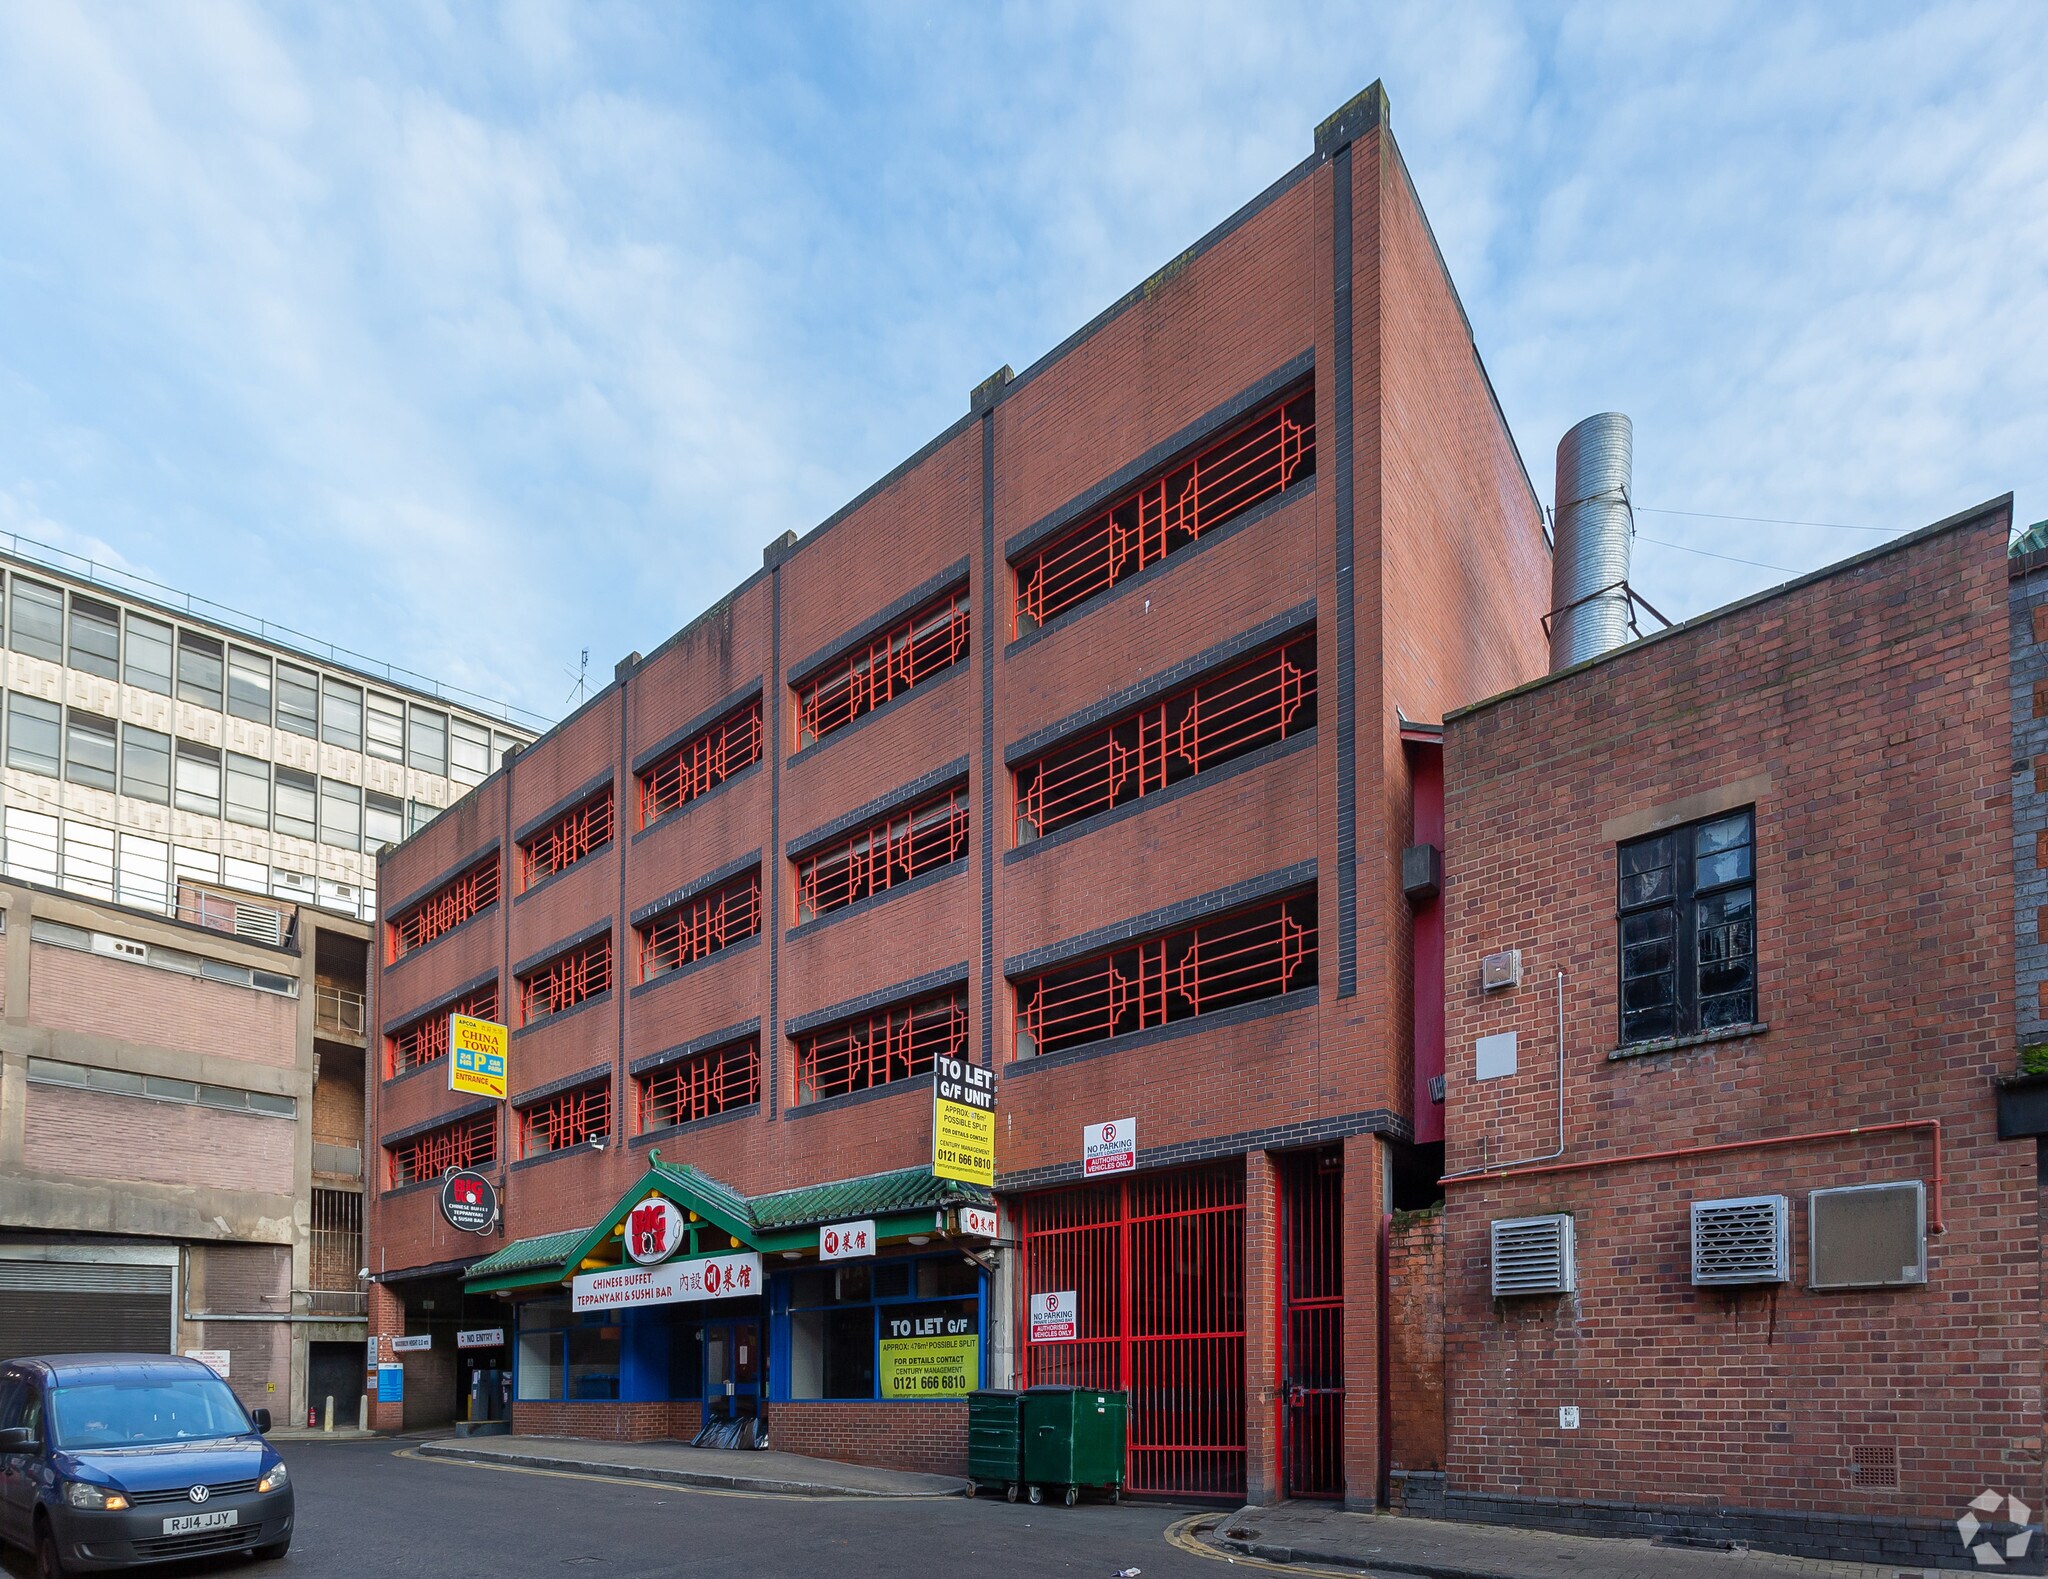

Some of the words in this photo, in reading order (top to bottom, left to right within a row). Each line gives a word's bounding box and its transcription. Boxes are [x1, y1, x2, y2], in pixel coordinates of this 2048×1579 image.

[459, 1020, 476, 1028] APCOA
[462, 1030, 499, 1045] CHINA
[464, 1040, 499, 1055] TOWN
[474, 1053, 486, 1070] P
[456, 1073, 488, 1085] ENTRANCE
[940, 1056, 960, 1080] TO
[966, 1064, 992, 1088] LET
[940, 1081, 961, 1099] G/F
[965, 1088, 991, 1108] UNIT
[945, 1105, 970, 1117] APPROX:
[944, 1115, 971, 1128] POSSIBLE
[972, 1122, 987, 1131] SPLIT
[952, 1130, 969, 1138] DETAILS
[970, 1134, 988, 1142] CONTACT
[940, 1140, 960, 1149] CENTURY
[961, 1144, 990, 1155] MANAGEMENT
[1088, 1145, 1098, 1153] NO
[1100, 1139, 1132, 1151] PARKING
[938, 1149, 956, 1162] 0121
[959, 1153, 972, 1166] 666
[974, 1157, 990, 1170] 6810
[1092, 1154, 1127, 1165] AUTHORISED
[1088, 1163, 1115, 1172] VEHICLES
[454, 1178, 483, 1194] BIG
[632, 1205, 666, 1235] BIG
[593, 1276, 622, 1289] CHINESE
[625, 1273, 654, 1286] BUFFET,
[577, 1292, 623, 1306] TEPPANYAKI
[632, 1288, 654, 1300] SUSHI
[656, 1286, 672, 1298] BAR
[1044, 1311, 1072, 1319] PARKING
[891, 1320, 911, 1336] TO
[915, 1318, 943, 1335] LET
[947, 1319, 968, 1333] G/F
[467, 1334, 474, 1343] NO
[476, 1333, 492, 1342] ENTRY
[929, 1340, 958, 1349] POSSIBLE
[894, 1377, 917, 1389] 0121
[921, 1376, 939, 1389] 666
[942, 1376, 966, 1388] 6810
[172, 1517, 201, 1530] RJ14
[205, 1513, 228, 1526] JJY
